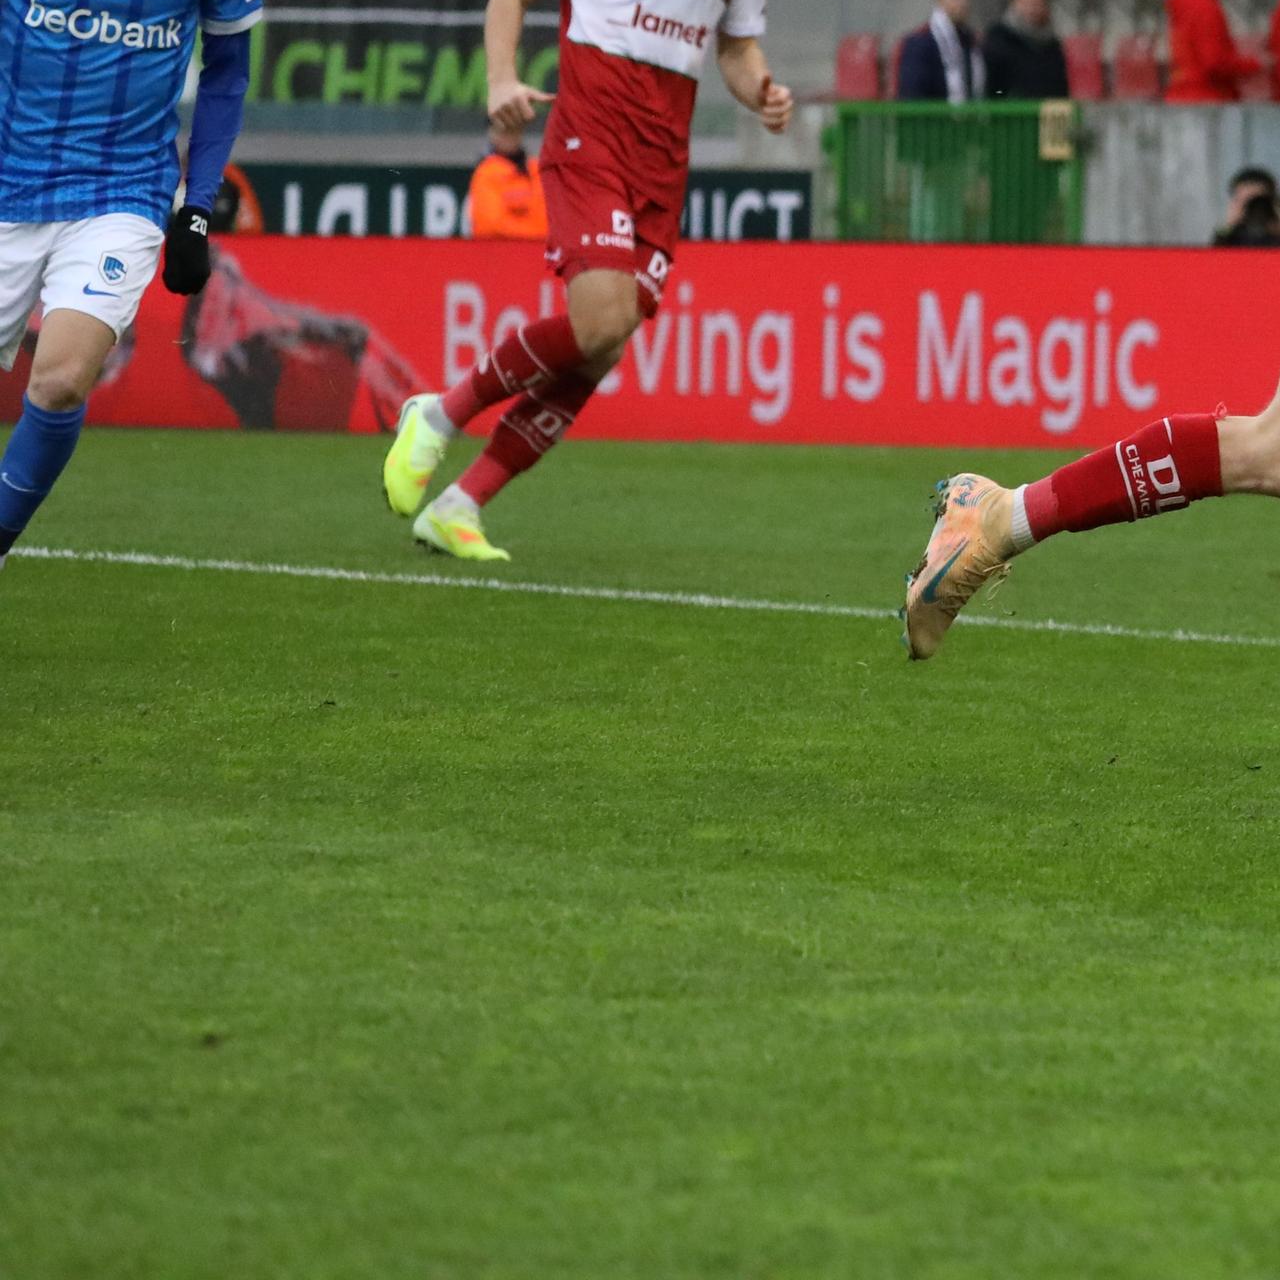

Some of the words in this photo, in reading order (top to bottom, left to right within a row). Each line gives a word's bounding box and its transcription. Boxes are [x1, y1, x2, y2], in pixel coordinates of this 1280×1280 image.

[190, 214, 208, 237] 20
[823, 283, 885, 403] is
[917, 289, 1161, 435] Magic
[1146, 453, 1187, 514] DL
